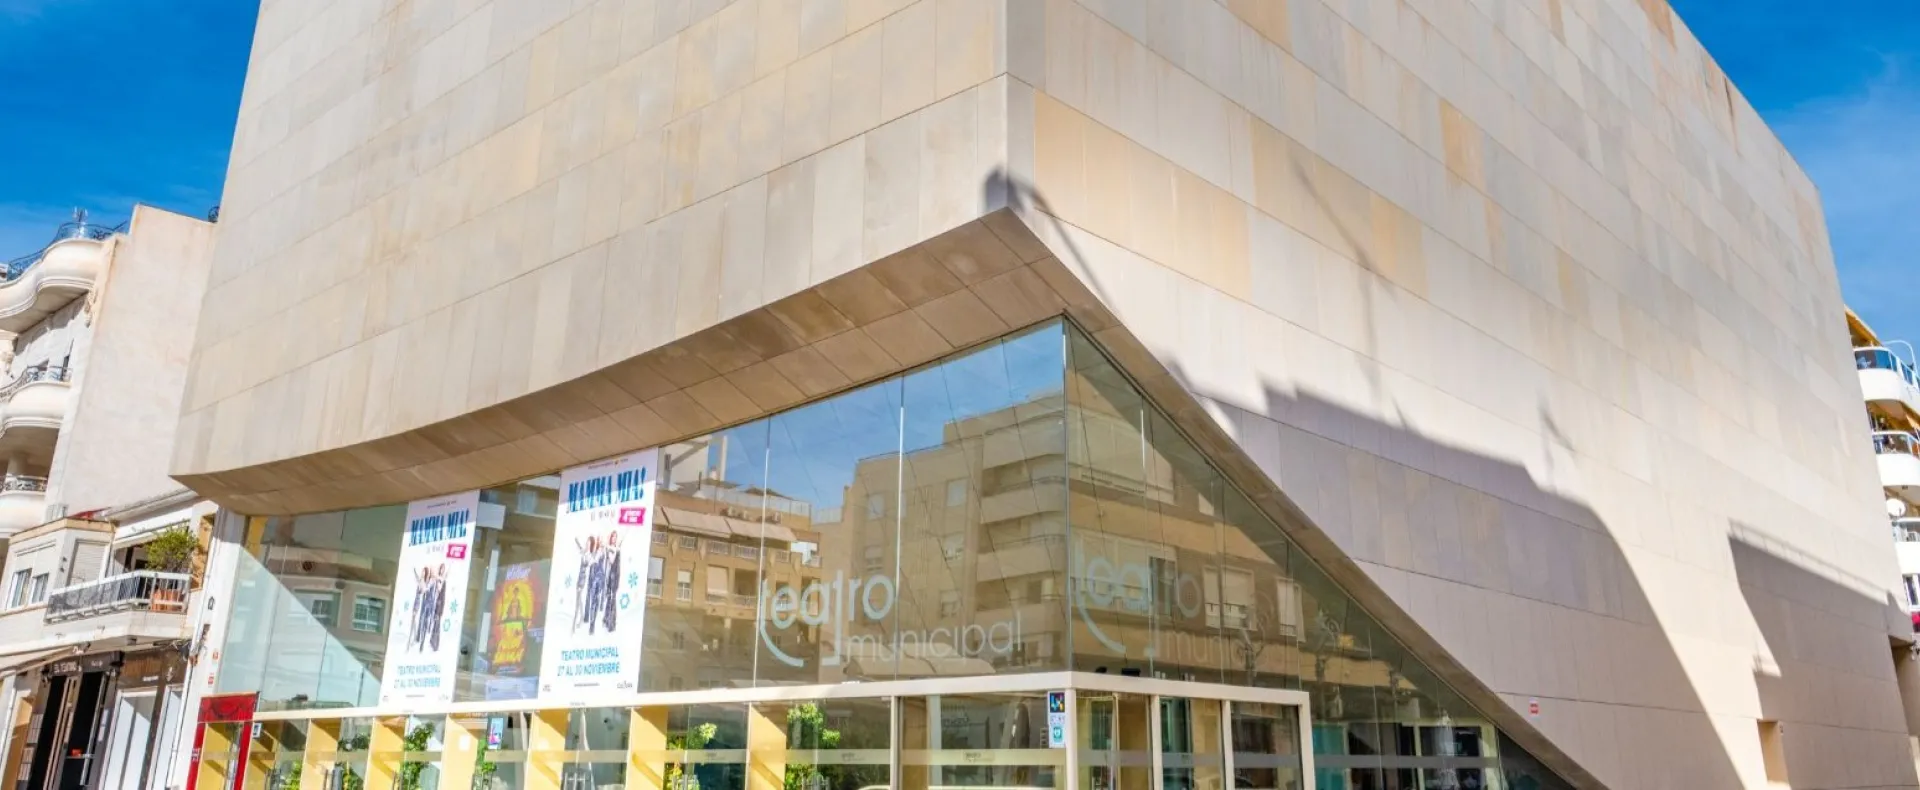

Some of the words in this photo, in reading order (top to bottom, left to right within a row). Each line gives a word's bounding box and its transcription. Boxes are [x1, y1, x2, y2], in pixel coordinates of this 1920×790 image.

[567, 475, 613, 513] MAMMA
[616, 466, 646, 503] MIA!
[409, 514, 444, 546] MAMMA
[759, 569, 895, 667] teatro
[847, 610, 1022, 663] municipal
[561, 648, 585, 662] TEATRO
[585, 645, 619, 660] MUNICIPAL
[583, 661, 620, 676] NOVIEMBRE
